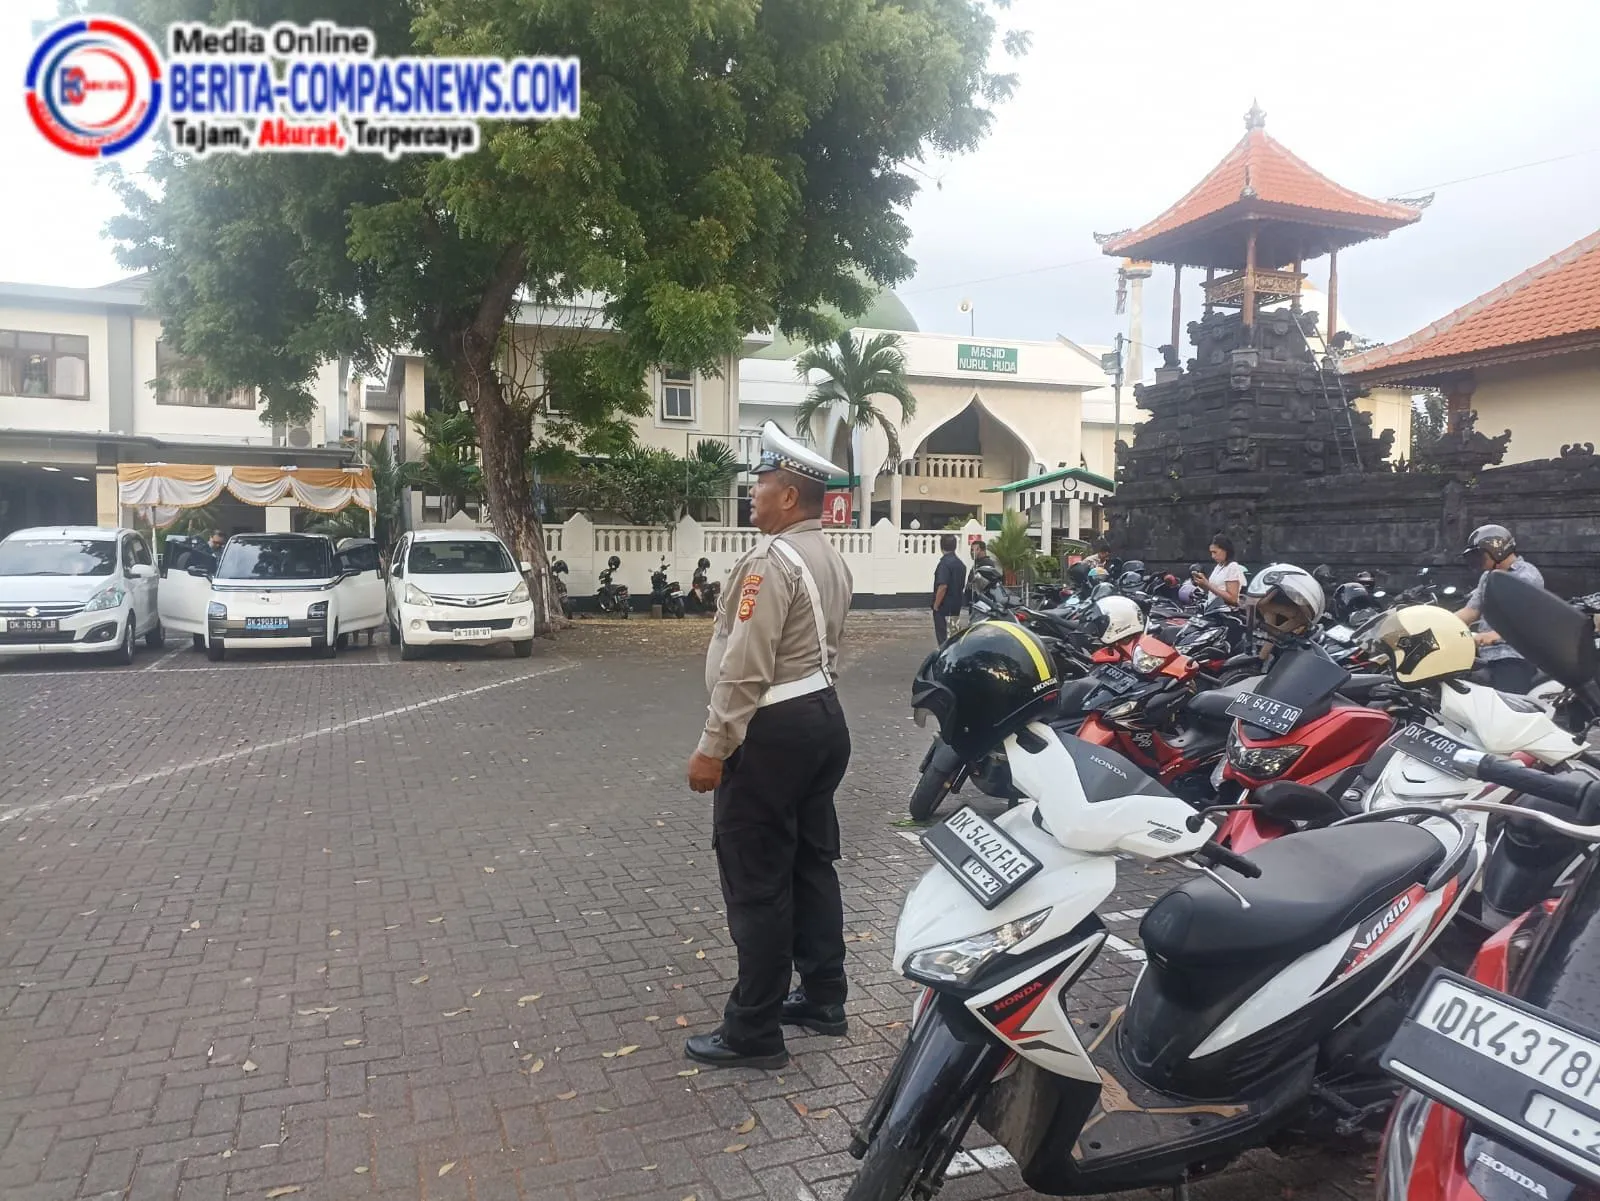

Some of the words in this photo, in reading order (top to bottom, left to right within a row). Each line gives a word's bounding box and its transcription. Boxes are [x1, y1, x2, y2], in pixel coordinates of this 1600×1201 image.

[959, 357, 989, 370] NURUL
[992, 360, 1016, 373] HUDA
[970, 345, 1006, 359] MASJID
[1032, 677, 1058, 693] HONDA
[1236, 693, 1252, 705] DK
[1252, 698, 1281, 715] 6415
[1404, 725, 1426, 740] DK
[1423, 734, 1457, 754] 4408
[1090, 754, 1128, 780] HONDA
[1352, 894, 1410, 949] VARIO
[993, 981, 1043, 1012] HONDA
[1476, 1151, 1549, 1201] HONDA
